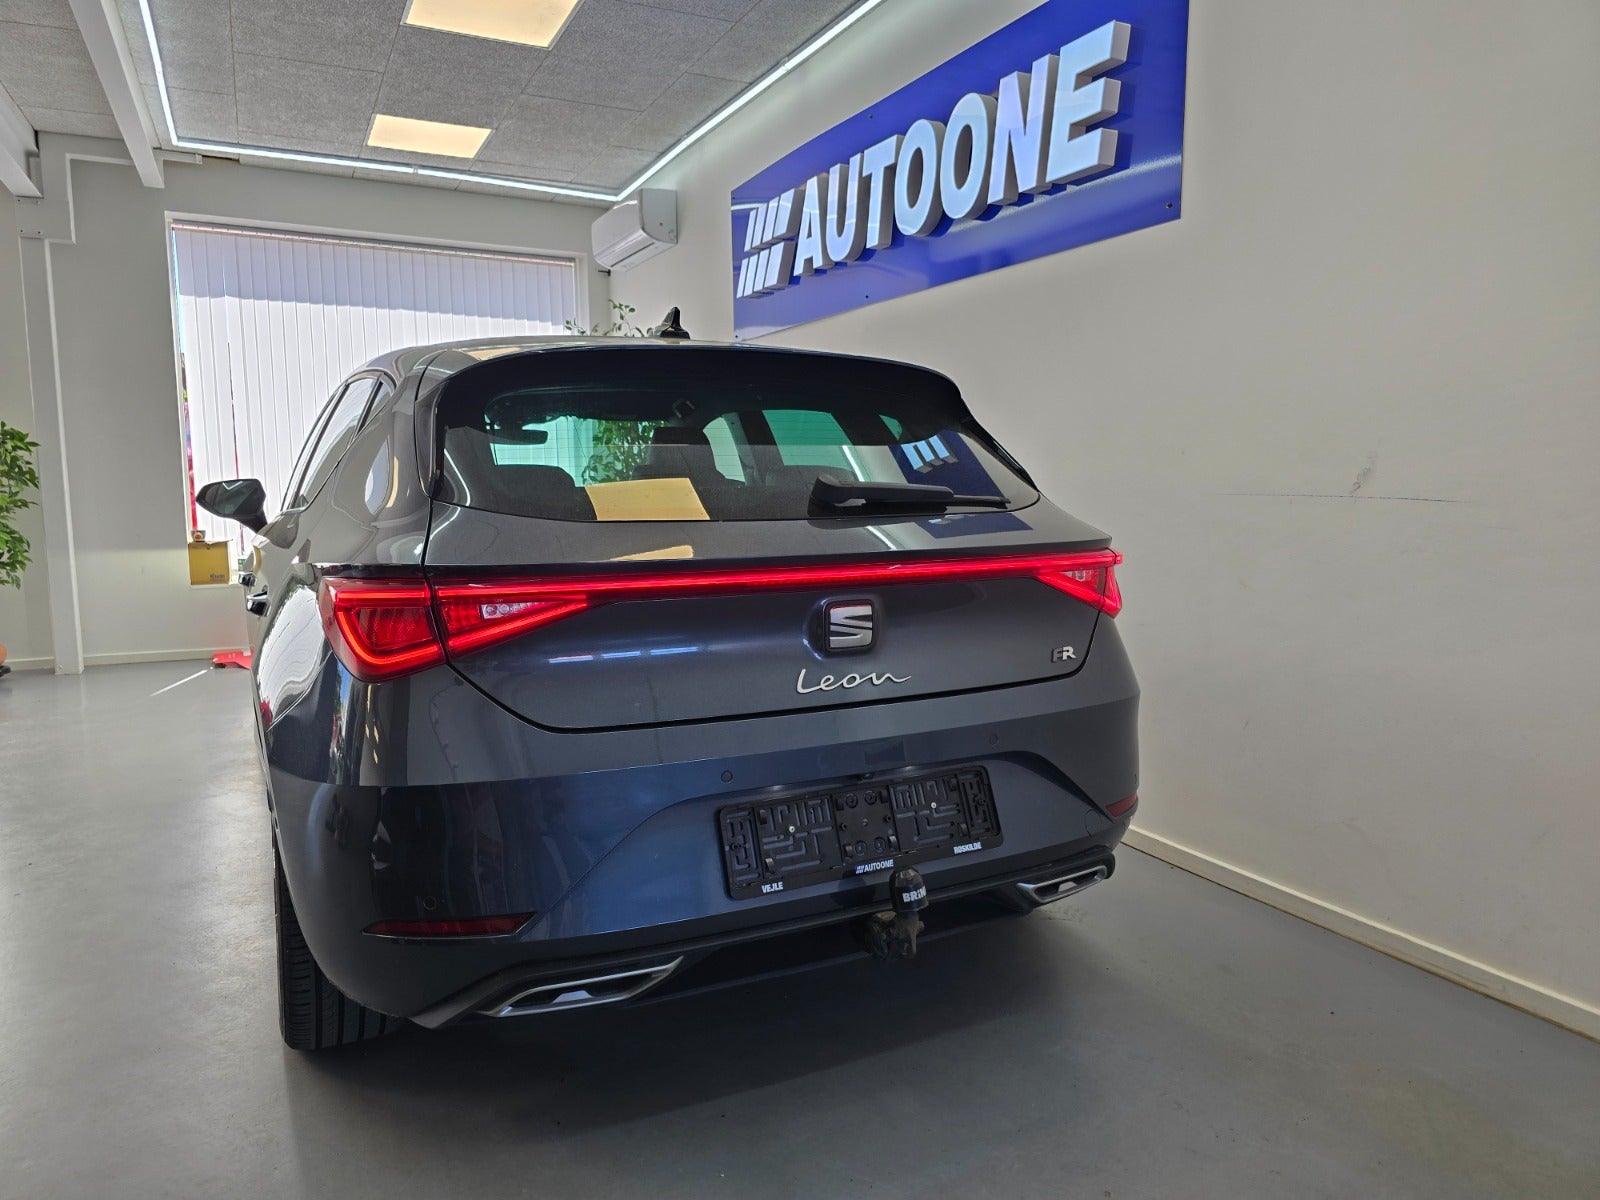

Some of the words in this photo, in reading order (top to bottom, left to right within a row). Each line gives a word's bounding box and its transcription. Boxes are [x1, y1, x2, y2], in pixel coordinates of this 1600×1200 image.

[793, 19, 1131, 277] AUTOONE
[1052, 645, 1077, 662] FR
[796, 668, 912, 694] Leon
[863, 858, 895, 873] AUTOONE
[761, 881, 784, 894] VEJLE
